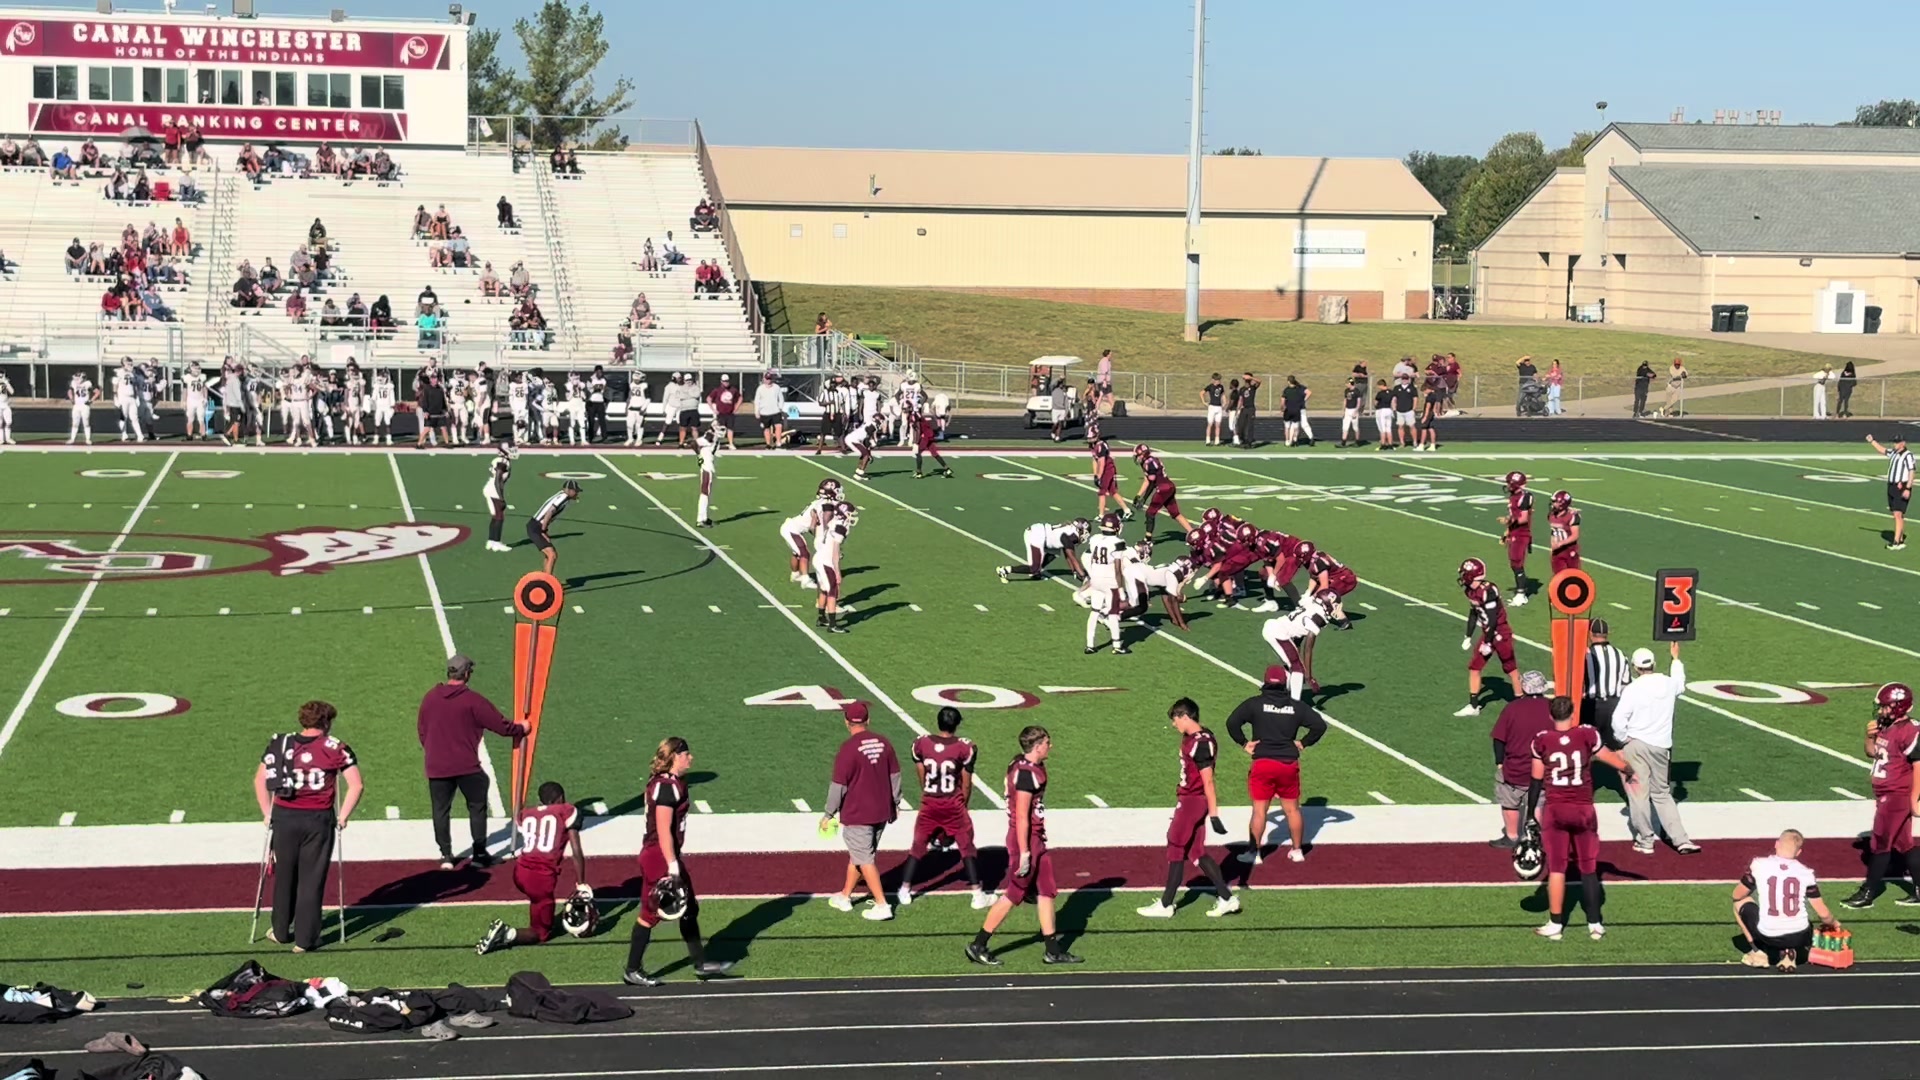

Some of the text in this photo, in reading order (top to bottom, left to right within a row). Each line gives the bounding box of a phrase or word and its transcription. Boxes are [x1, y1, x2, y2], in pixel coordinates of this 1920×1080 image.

[73, 23, 362, 51] CANAL WINCHESTER
[115, 47, 325, 64] HOME OF THE INDIANS
[74, 111, 148, 127] CANAL
[275, 117, 361, 133] CENTER
[1092, 545, 1108, 565] 48
[1662, 576, 1694, 615] 3
[922, 757, 957, 794] 26
[1549, 750, 1583, 786] 21
[521, 815, 558, 853] 80
[1766, 875, 1801, 918] 18
